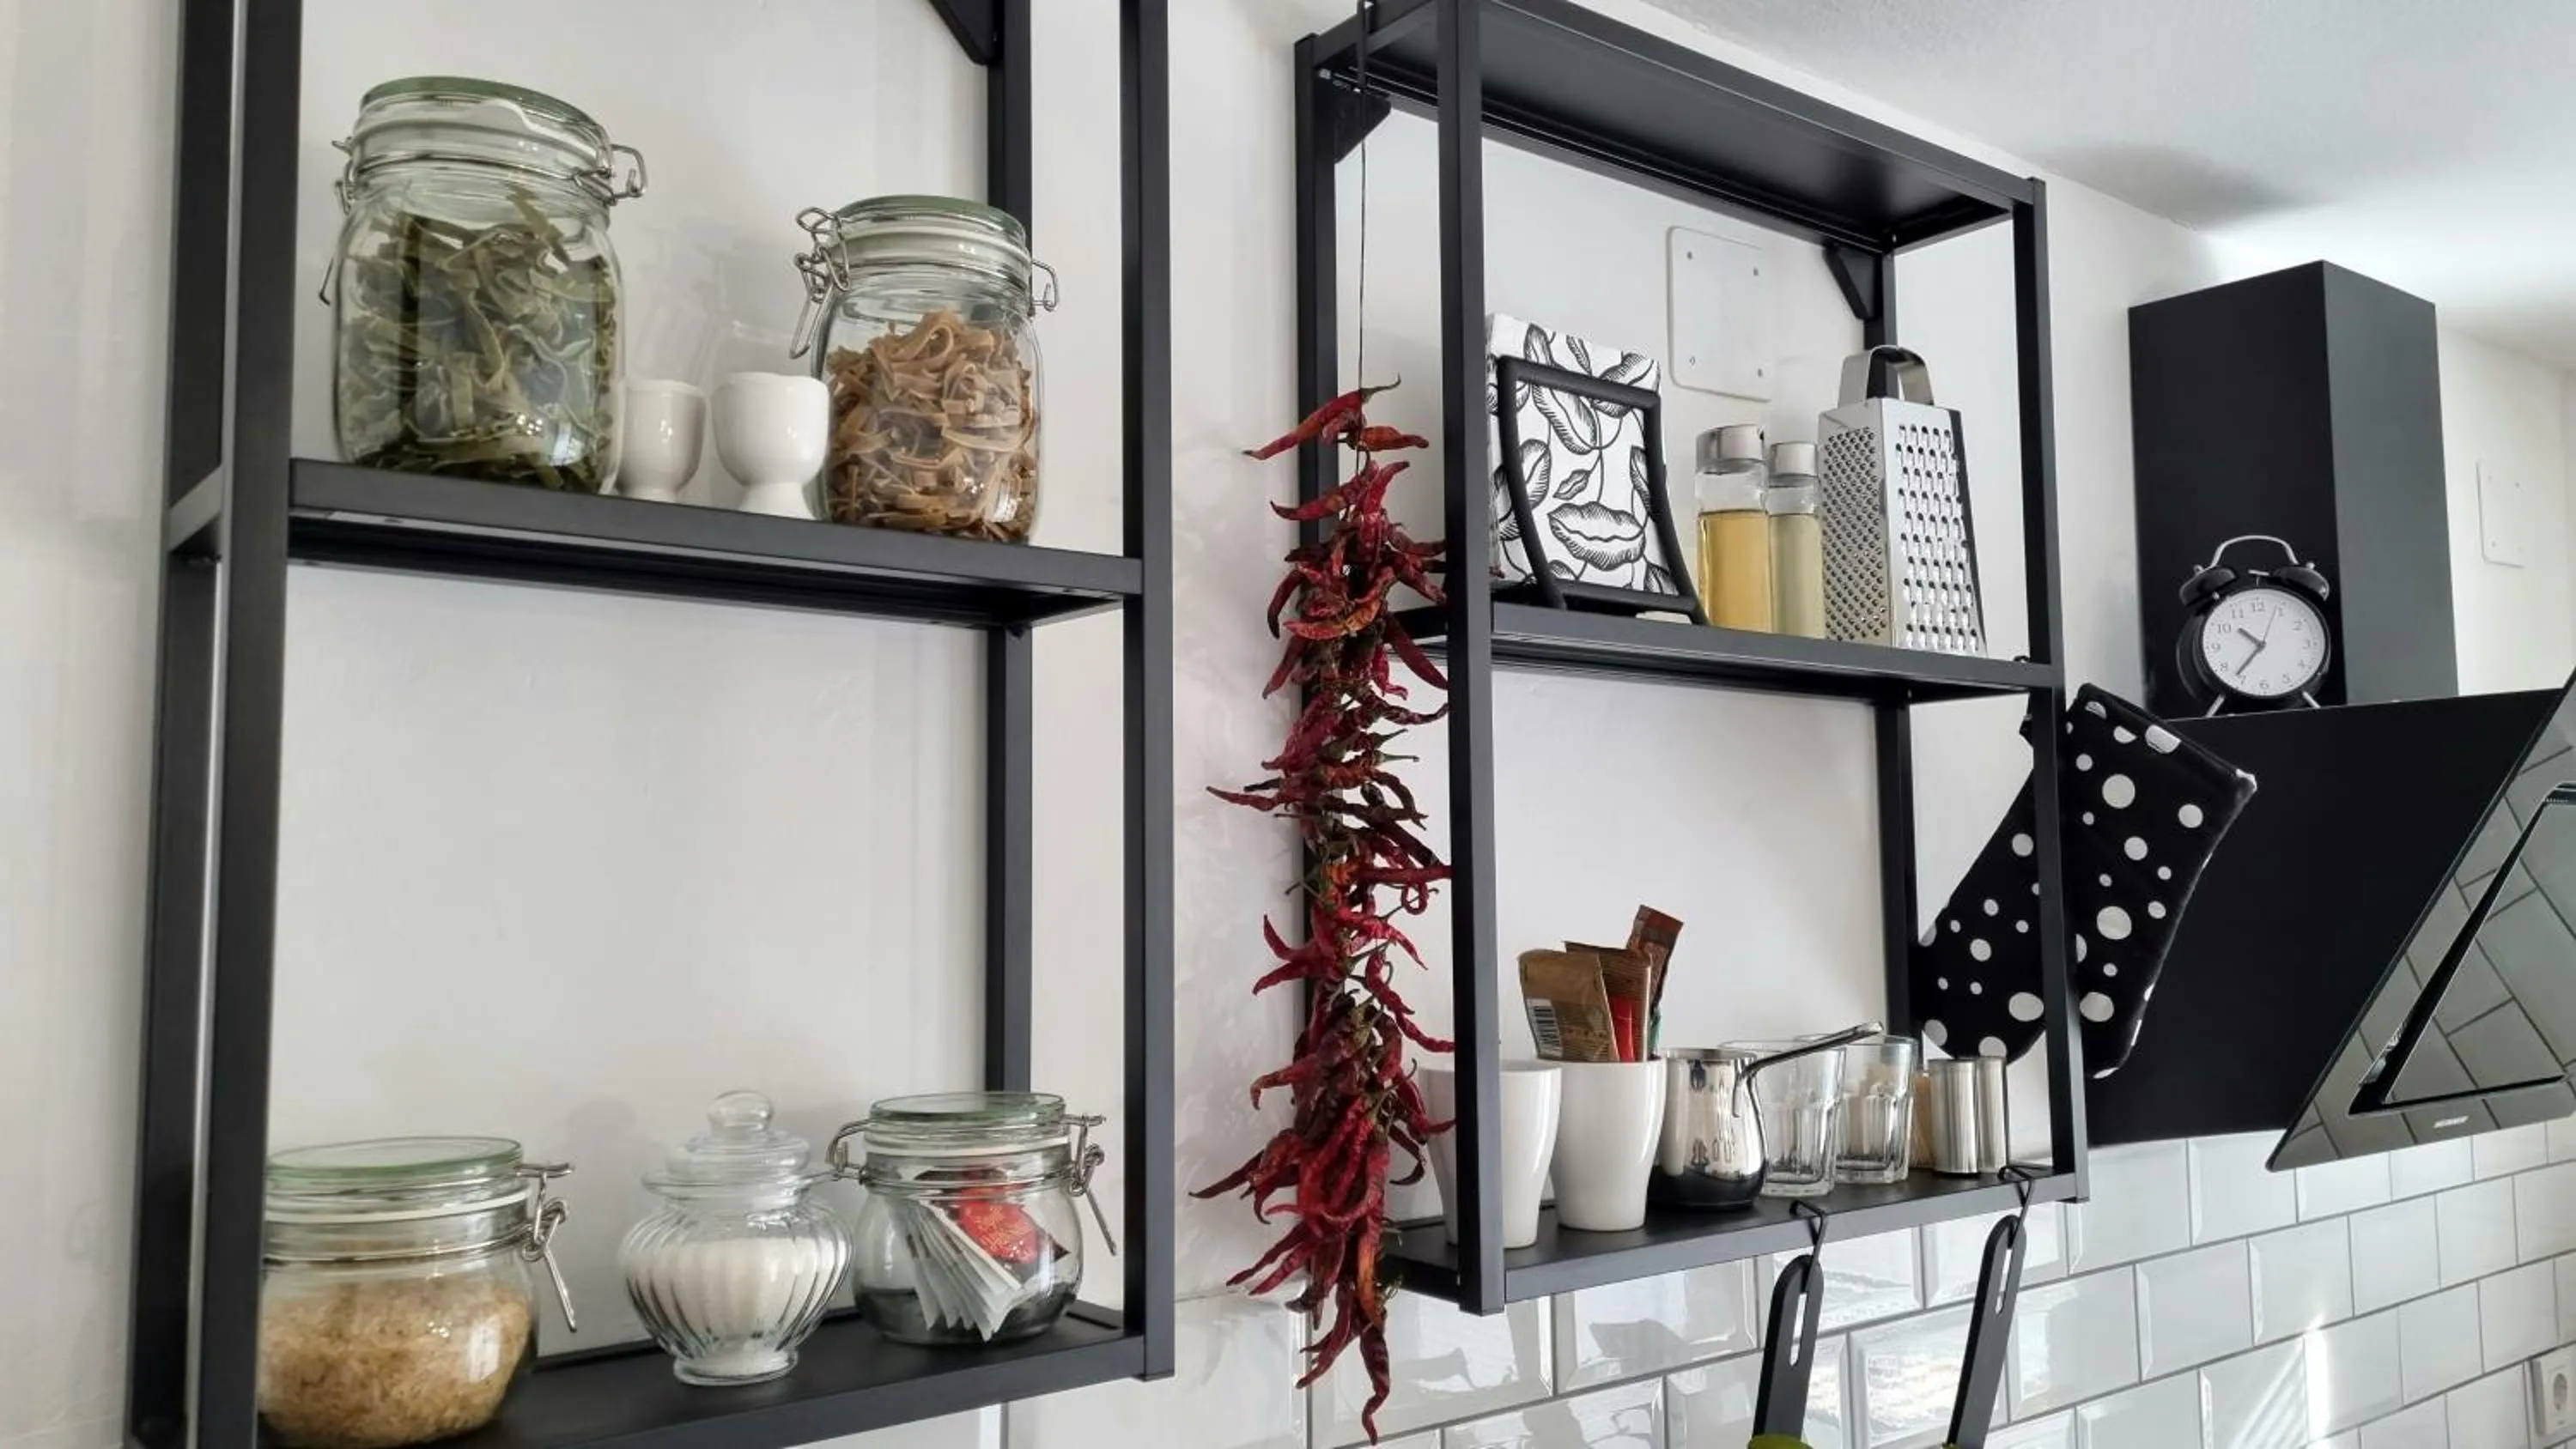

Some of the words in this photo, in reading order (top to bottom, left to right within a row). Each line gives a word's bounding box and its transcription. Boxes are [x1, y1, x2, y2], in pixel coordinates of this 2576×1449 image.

[2251, 601, 2266, 612] 12
[2233, 608, 2244, 619] 11
[2217, 623, 2232, 634] 10
[2292, 620, 2302, 631] 2
